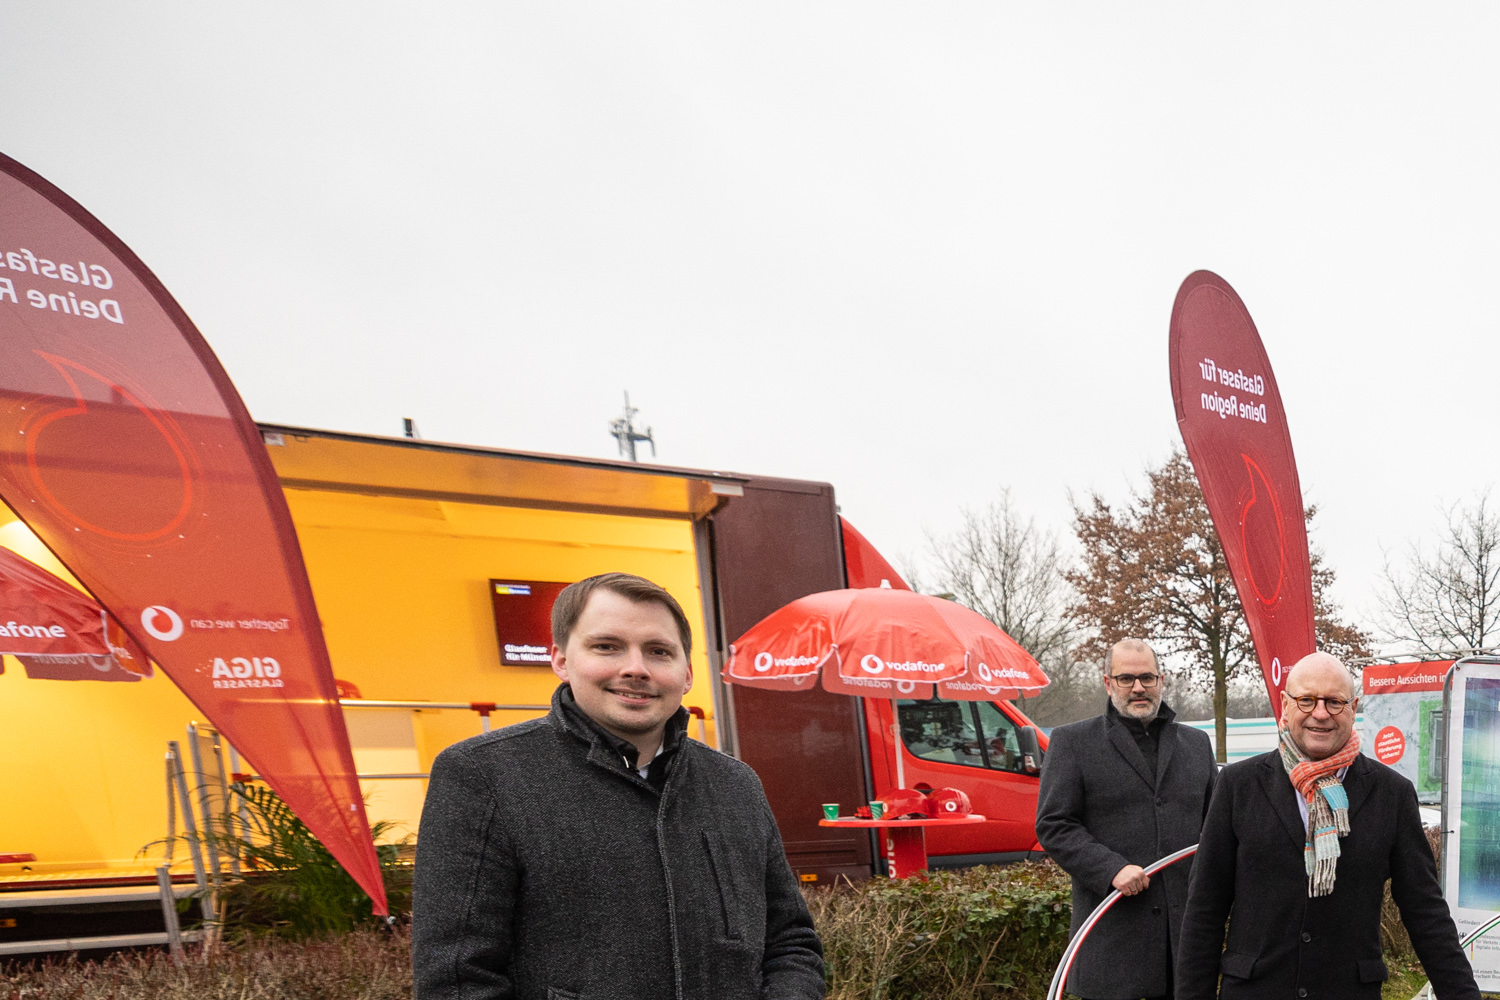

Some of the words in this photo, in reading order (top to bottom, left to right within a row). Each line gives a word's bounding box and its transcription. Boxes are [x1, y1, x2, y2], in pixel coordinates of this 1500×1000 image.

[885, 660, 946, 673] vodafone
[990, 667, 1030, 680] vodafone
[1369, 676, 1396, 687] Bessere
[1396, 673, 1438, 686] Aussichten
[1377, 743, 1402, 754] Förderung
